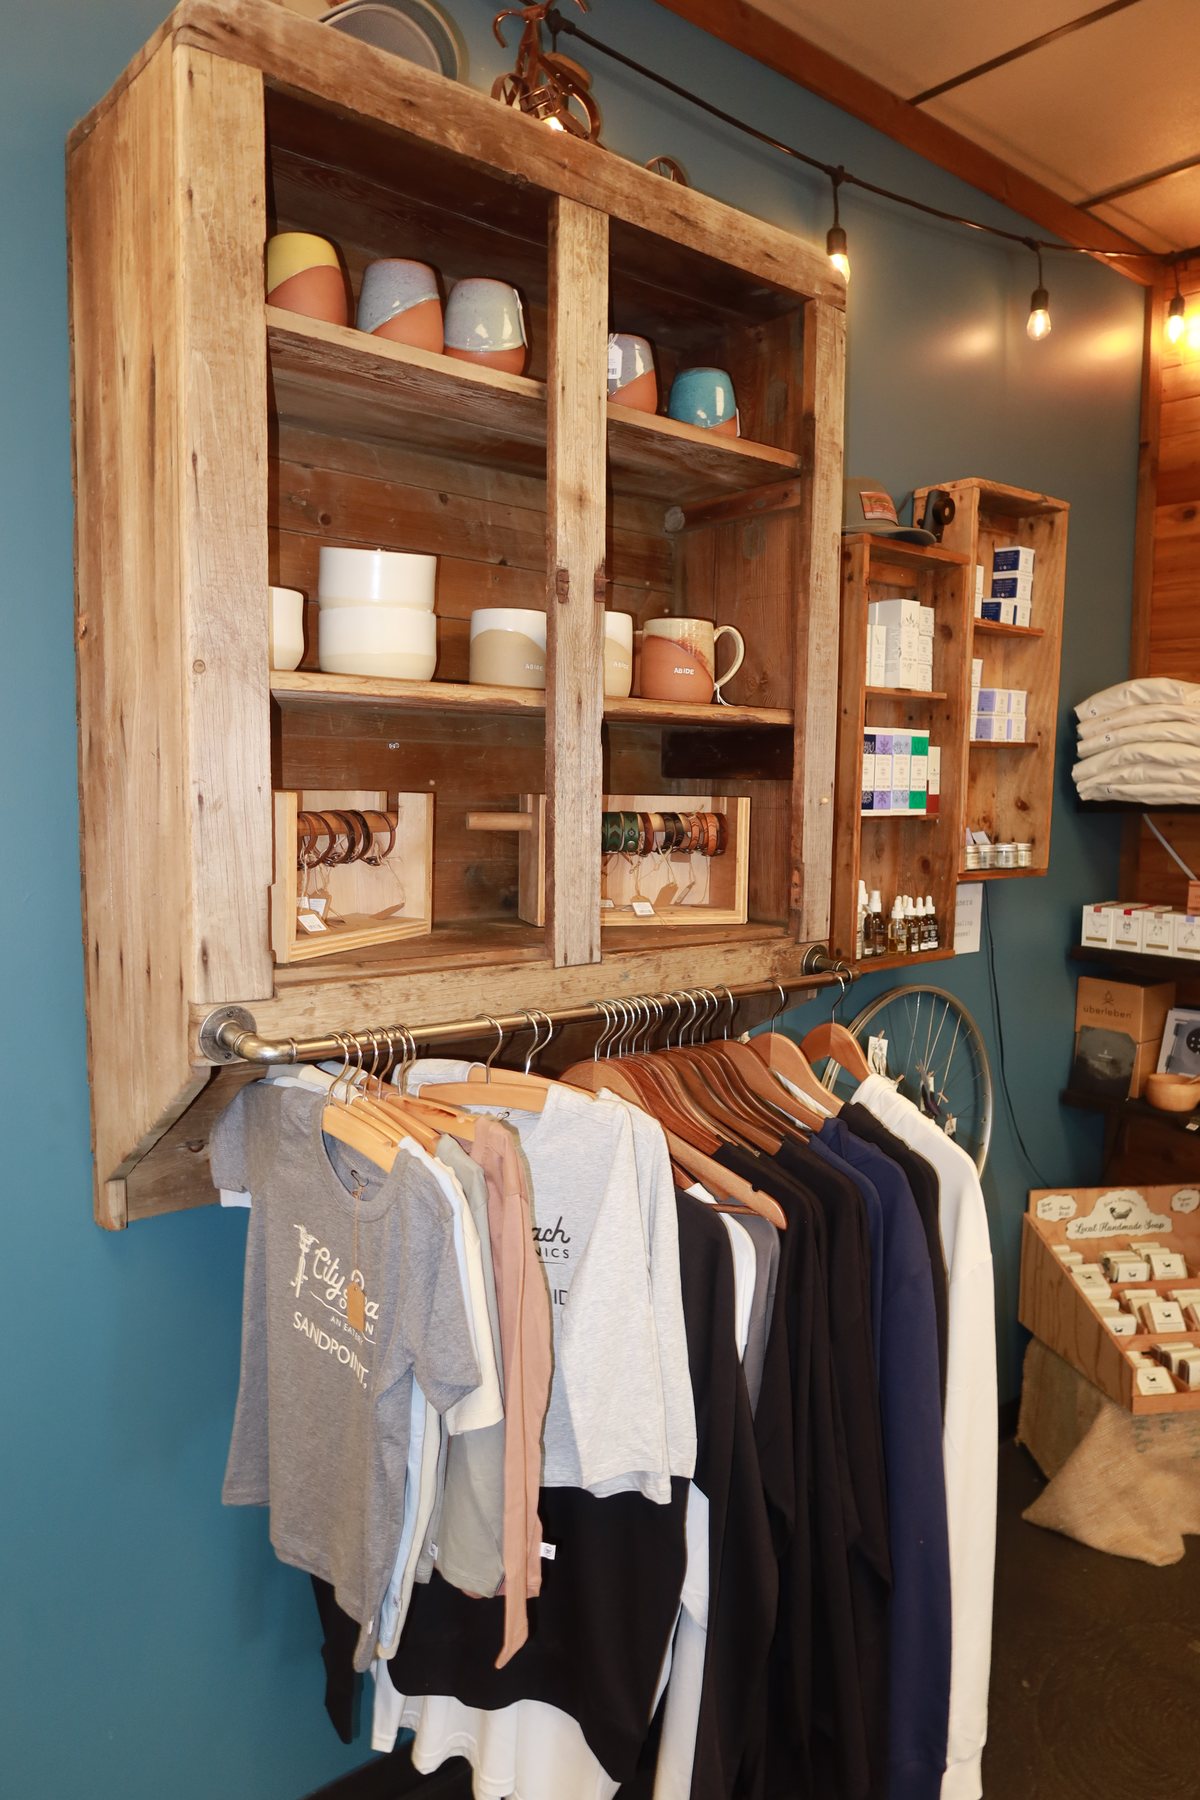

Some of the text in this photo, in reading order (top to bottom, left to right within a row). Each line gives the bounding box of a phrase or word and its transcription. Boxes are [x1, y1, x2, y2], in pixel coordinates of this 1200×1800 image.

[673, 667, 695, 675] ABIDE
[1075, 1219, 1165, 1234] Local Handmade Soap
[313, 1247, 345, 1301] City
[330, 1316, 341, 1327] AN
